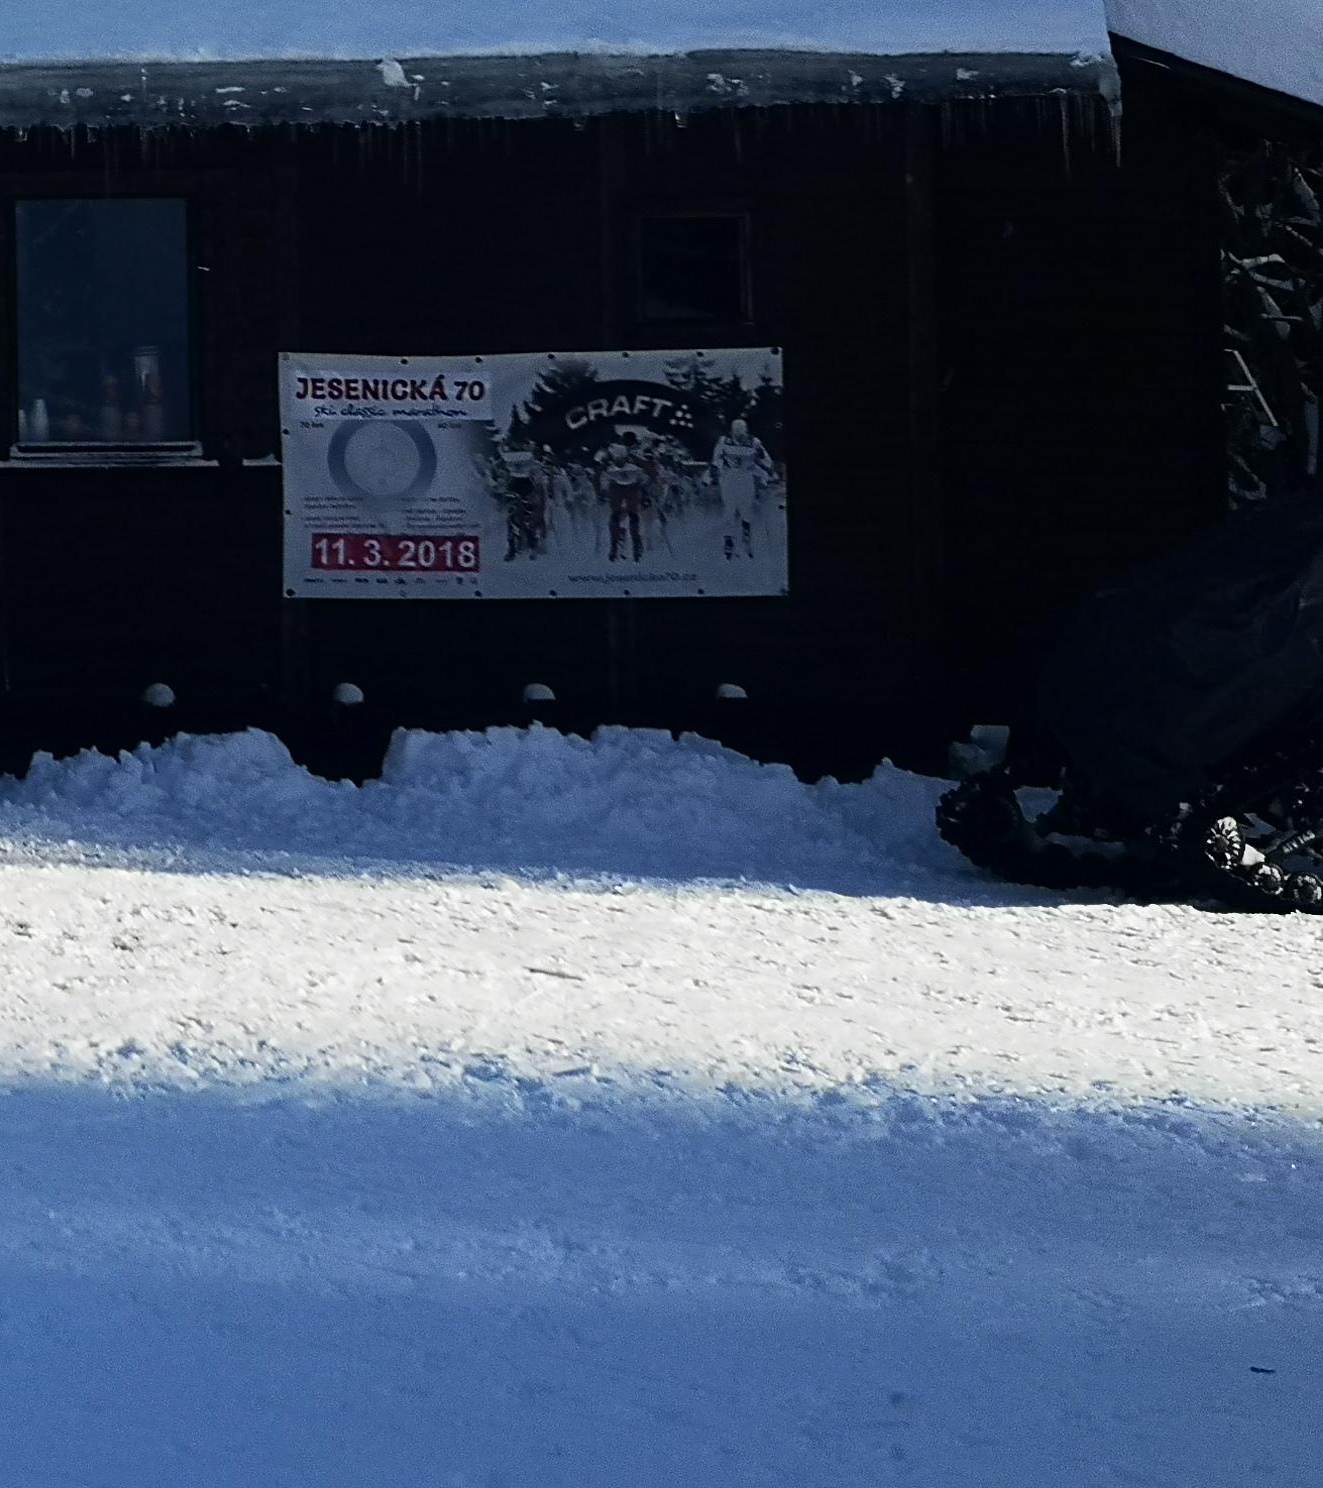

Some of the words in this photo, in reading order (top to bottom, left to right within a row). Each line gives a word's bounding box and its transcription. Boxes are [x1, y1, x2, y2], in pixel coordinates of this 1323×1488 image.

[296, 374, 448, 401] JESENICKÁ
[454, 380, 486, 401] 70
[565, 394, 673, 431] CRAFT
[315, 538, 355, 566] 11.
[362, 539, 389, 567] 3.
[398, 540, 476, 568] 2018
